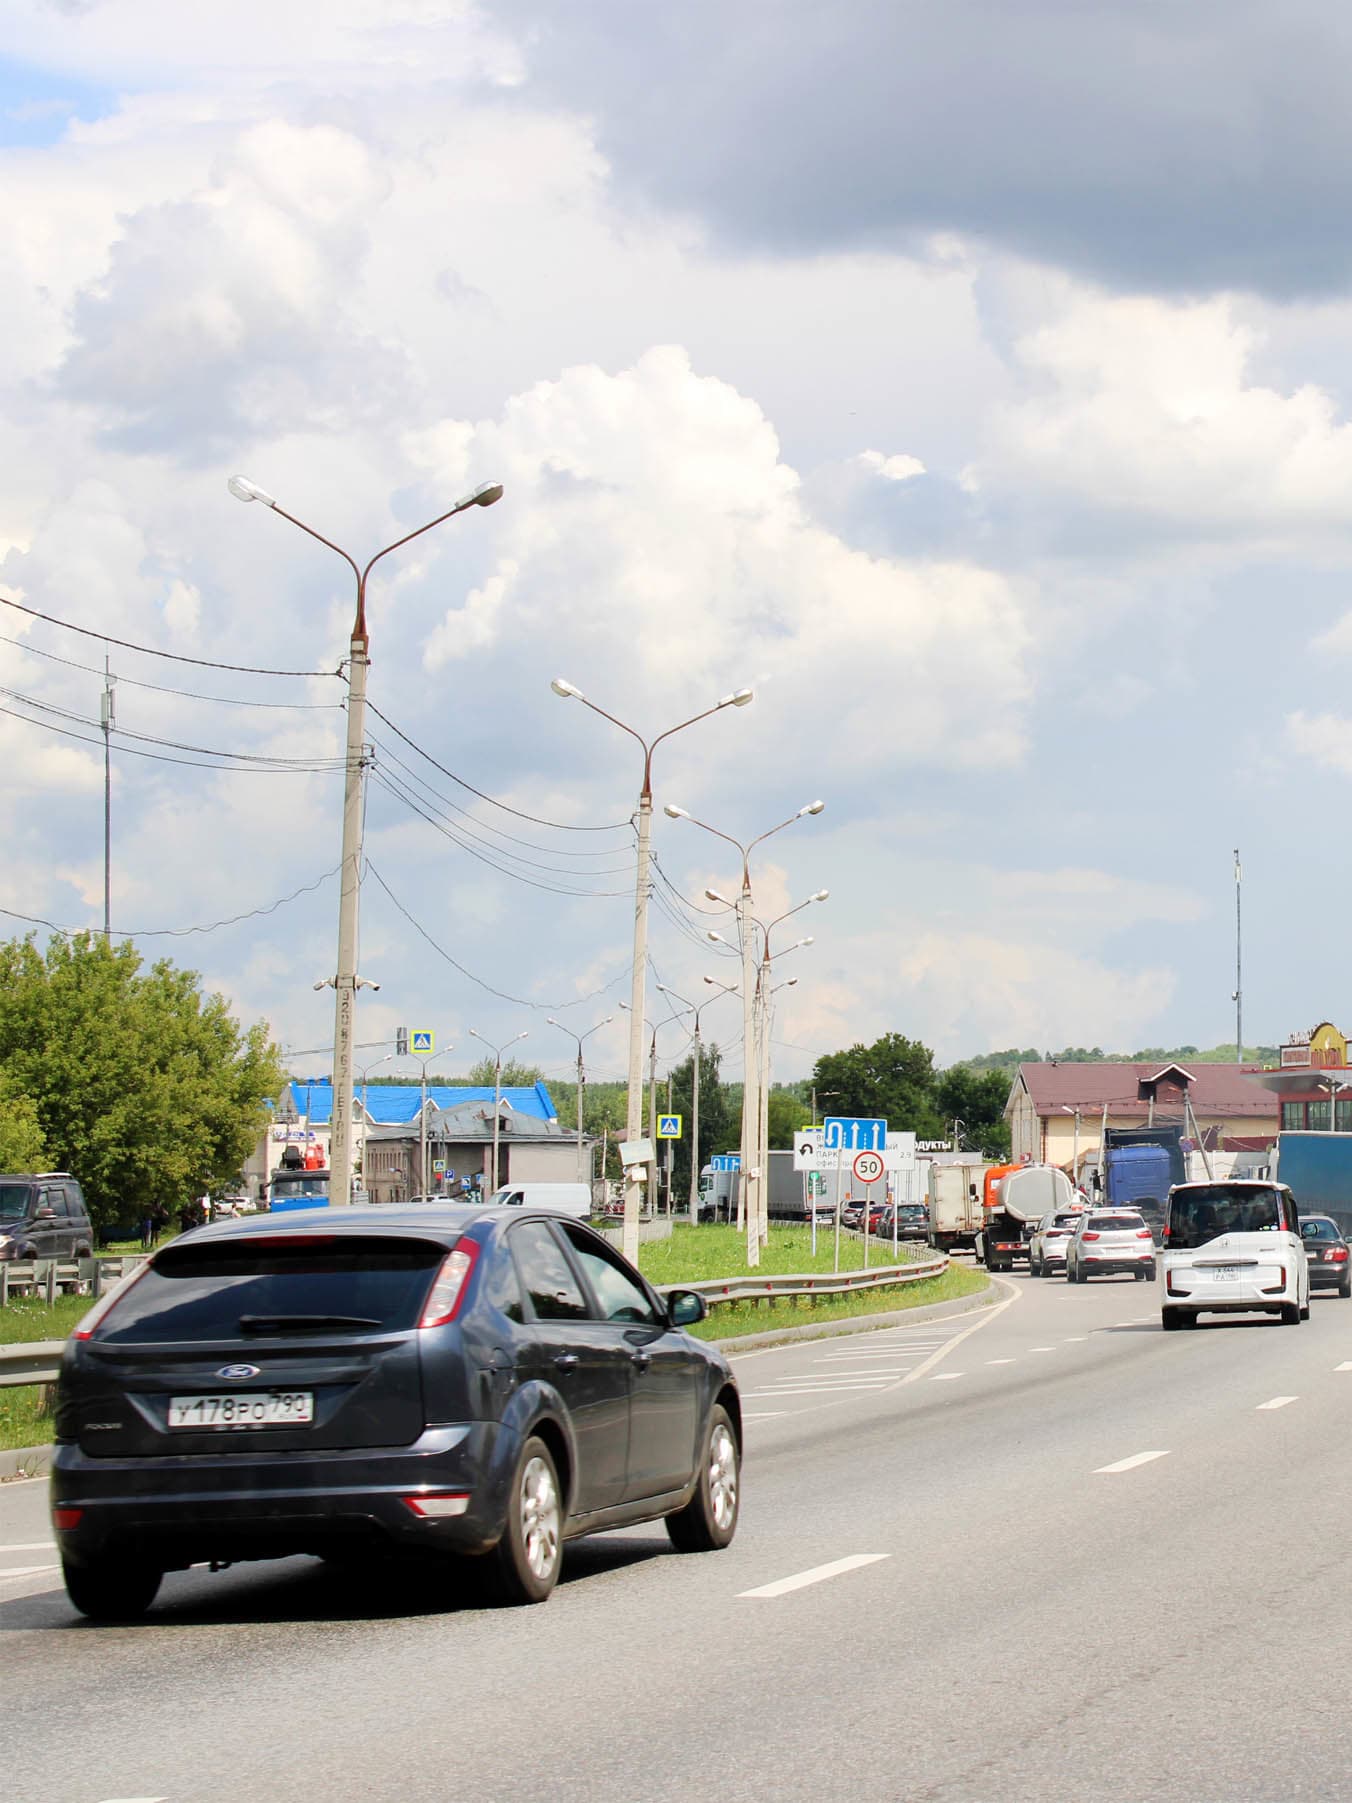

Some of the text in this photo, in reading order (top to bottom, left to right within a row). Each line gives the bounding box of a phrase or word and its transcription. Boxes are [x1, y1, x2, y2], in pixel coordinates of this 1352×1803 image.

[860, 1161, 878, 1174] 50
[177, 1395, 306, 1423] У178РО 790
